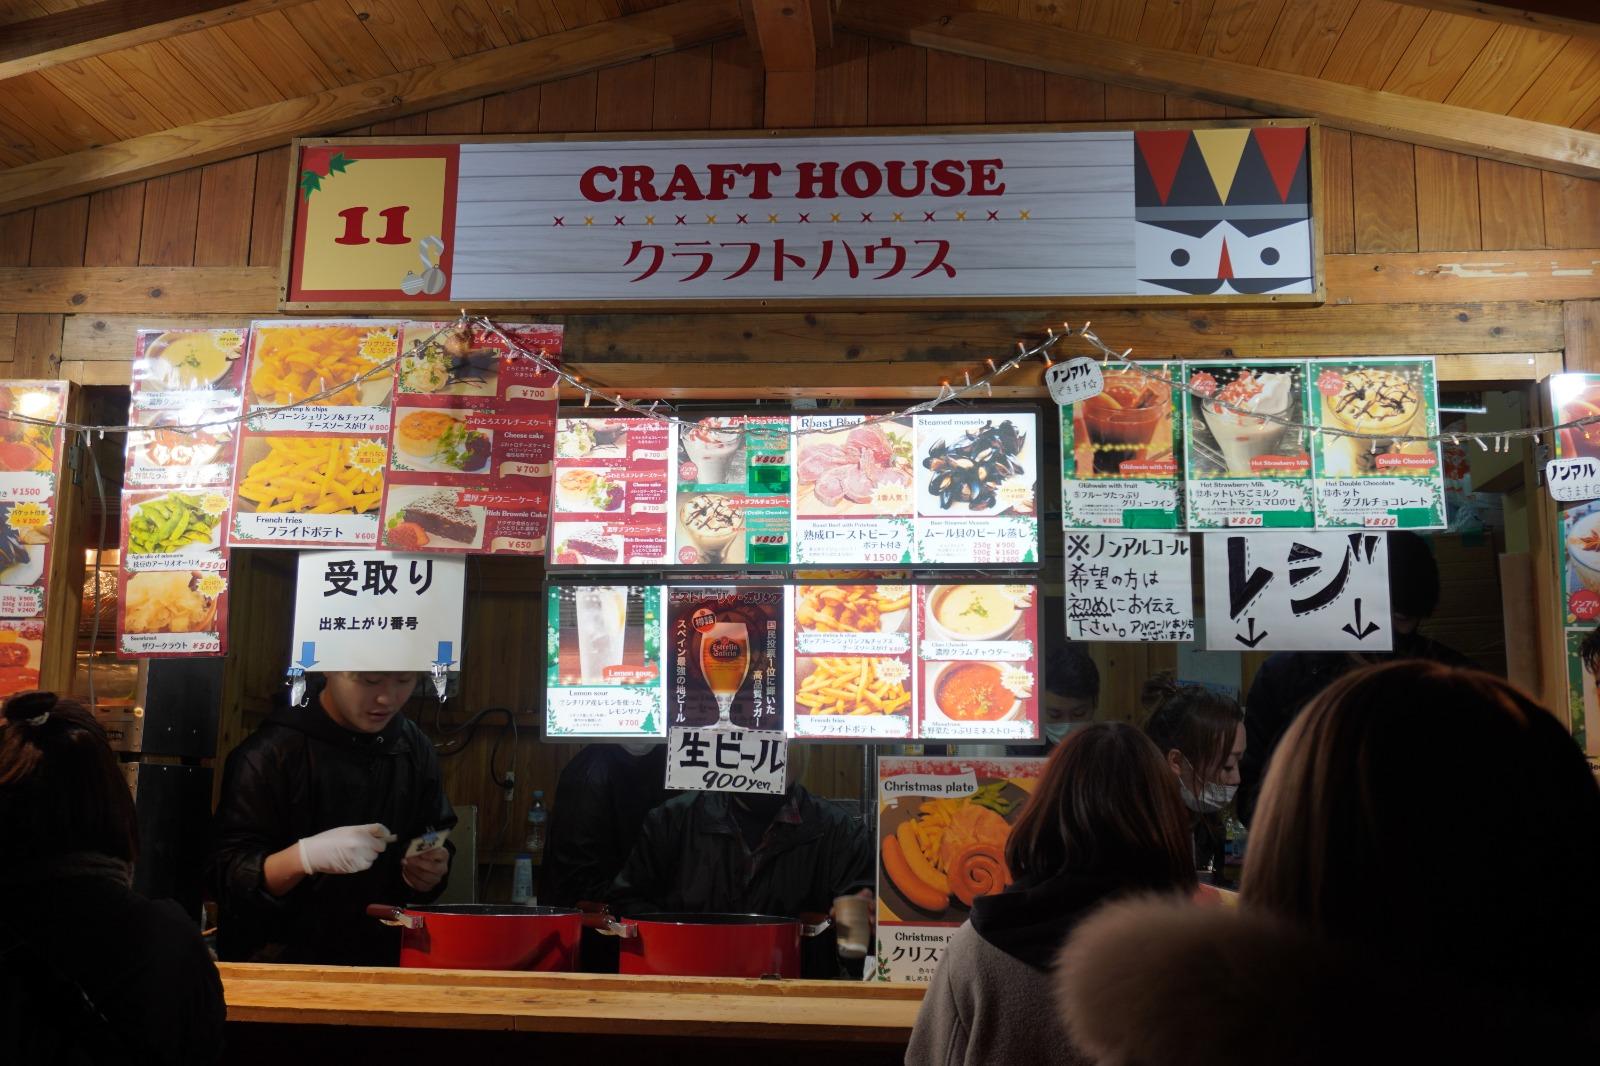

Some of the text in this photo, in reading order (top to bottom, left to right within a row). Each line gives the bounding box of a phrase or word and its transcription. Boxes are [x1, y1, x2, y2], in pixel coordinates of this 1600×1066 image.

[579, 158, 1006, 202] CRAFT HOUSE
[334, 206, 412, 246] 11
[622, 237, 957, 283] クラフトハウス
[1052, 363, 1092, 383] ノンアル
[522, 389, 545, 398] ¥700
[918, 418, 985, 426] Steamed mussels
[504, 431, 527, 439] Cheese
[1379, 457, 1436, 465] Double Chocolate
[516, 465, 540, 473] ¥700
[1550, 463, 1597, 481] ノンアル
[12, 487, 41, 496] ¥1500
[463, 493, 542, 504] 濃厚ブラウニーケーキ
[1122, 499, 1175, 507] グリューワイン
[1211, 498, 1297, 506] ハートマシュマロのせ
[1343, 498, 1428, 507] ダブルチョコレート
[486, 509, 501, 517] Rich
[502, 510, 529, 518] Brownie
[1231, 517, 1263, 525] ¥800
[1366, 518, 1397, 526] ¥800
[267, 526, 344, 538] フライドポテト
[803, 530, 899, 541] 熟成ローストビーフ
[924, 528, 1027, 539] ムール貝のビール蒸し
[508, 541, 532, 549] ¥650
[863, 541, 902, 549] ポテト付き
[864, 553, 898, 562] ¥1500
[200, 561, 226, 569] ¥500
[323, 559, 433, 597] 受取り
[1068, 563, 1159, 593] 希望の方は
[1227, 532, 1381, 623] レジ
[1067, 593, 1181, 616] 初めにお伝え
[319, 616, 419, 631] 出来上がり番号
[192, 642, 219, 650] ¥500
[712, 643, 738, 651] Estrella
[608, 669, 634, 679] Lemon
[675, 619, 687, 722] スペイン最強の地ビール
[618, 719, 639, 727] ¥700
[820, 724, 876, 734] フライドポテト
[677, 731, 784, 774] 生ビール
[884, 780, 975, 794] Christmas plate
[894, 931, 944, 943] Christmas
